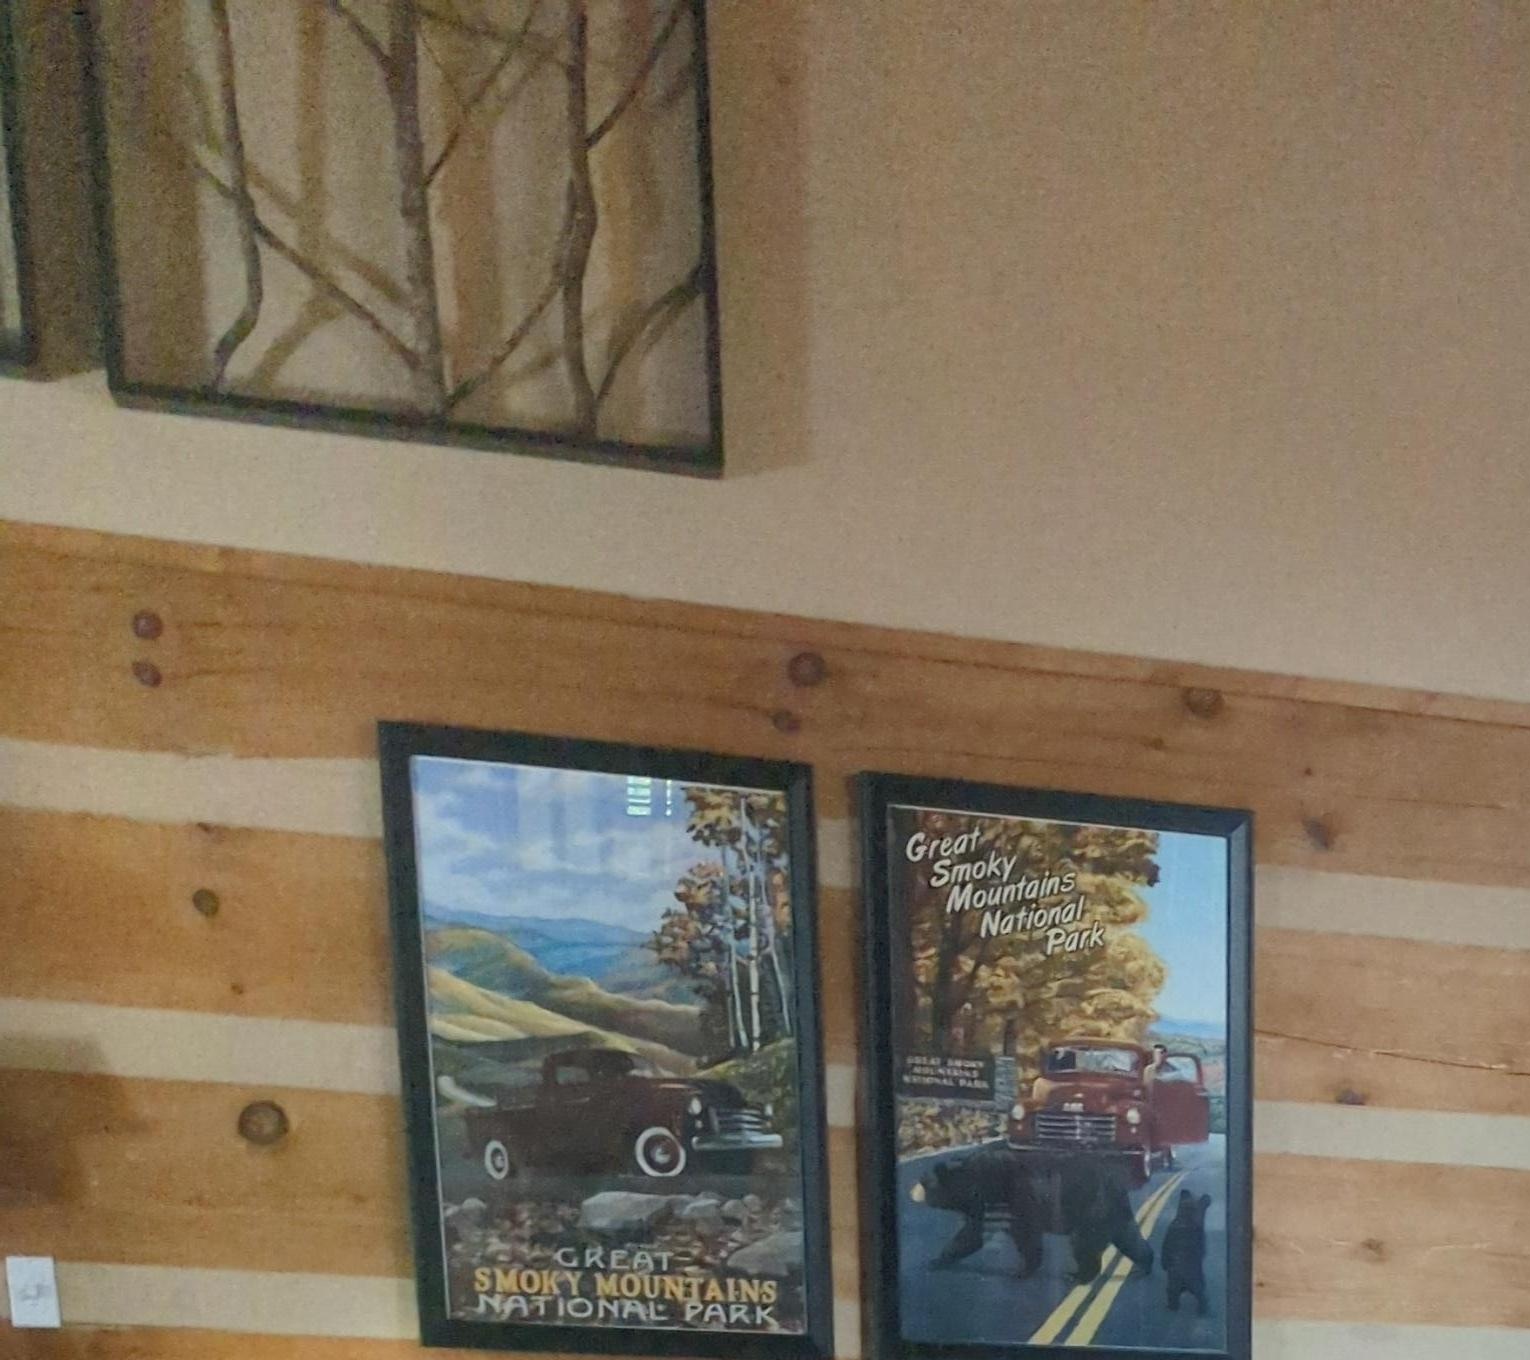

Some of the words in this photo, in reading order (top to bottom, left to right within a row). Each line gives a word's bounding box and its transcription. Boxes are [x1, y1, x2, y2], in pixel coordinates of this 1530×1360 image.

[906, 827, 981, 862] Great
[930, 851, 1017, 888] Smoky
[946, 871, 1076, 914] Mountains
[980, 896, 1085, 938] National
[1046, 922, 1105, 955] Park
[555, 1247, 674, 1271] GREAT
[474, 1267, 582, 1296] SMOKY
[595, 1273, 778, 1304] MOUNTAINS
[477, 1294, 669, 1321] NATIONAL
[685, 1304, 779, 1330] PARK
